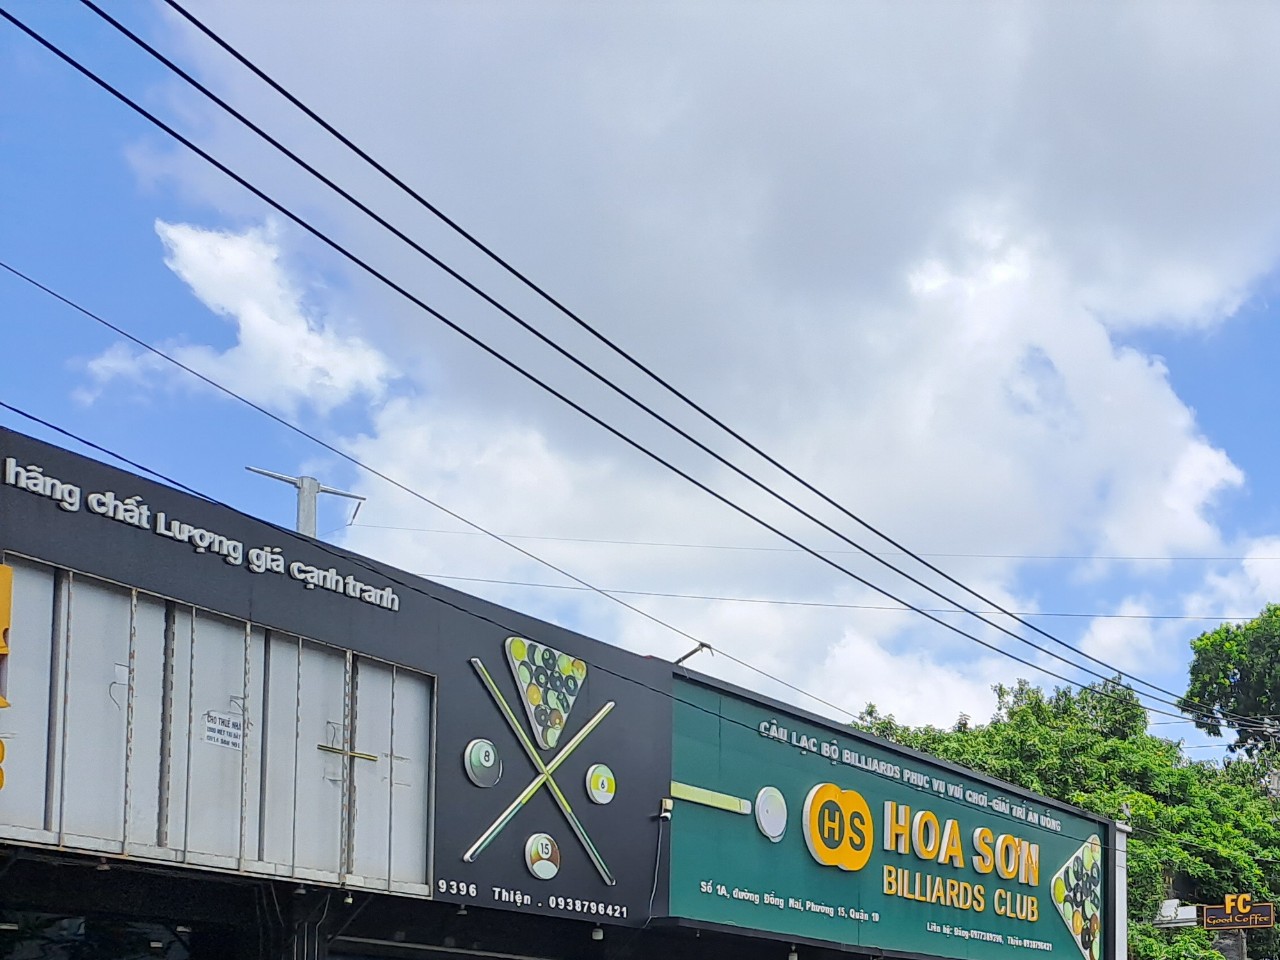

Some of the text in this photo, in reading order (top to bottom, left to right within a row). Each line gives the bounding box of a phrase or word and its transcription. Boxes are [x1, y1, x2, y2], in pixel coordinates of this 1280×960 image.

[5, 457, 400, 612] hãng chất Lượng giá cạnh tranh
[791, 732, 818, 755] LẠC
[821, 740, 839, 765] BỘ
[842, 749, 901, 779] BILLIARDS
[903, 769, 929, 791] PHỤC
[932, 778, 945, 798] VỤ
[884, 800, 1040, 887] HOA SƠN
[438, 880, 478, 897] 9396
[493, 888, 532, 907] Thiện
[549, 896, 628, 918] 0938796421
[700, 880, 713, 894] Số
[732, 887, 760, 905] đường
[763, 891, 784, 909] Đồng
[883, 865, 1039, 922] BILLIARDS CLUB
[1225, 893, 1252, 914] FC
[1207, 913, 1270, 926] Good Coffee
